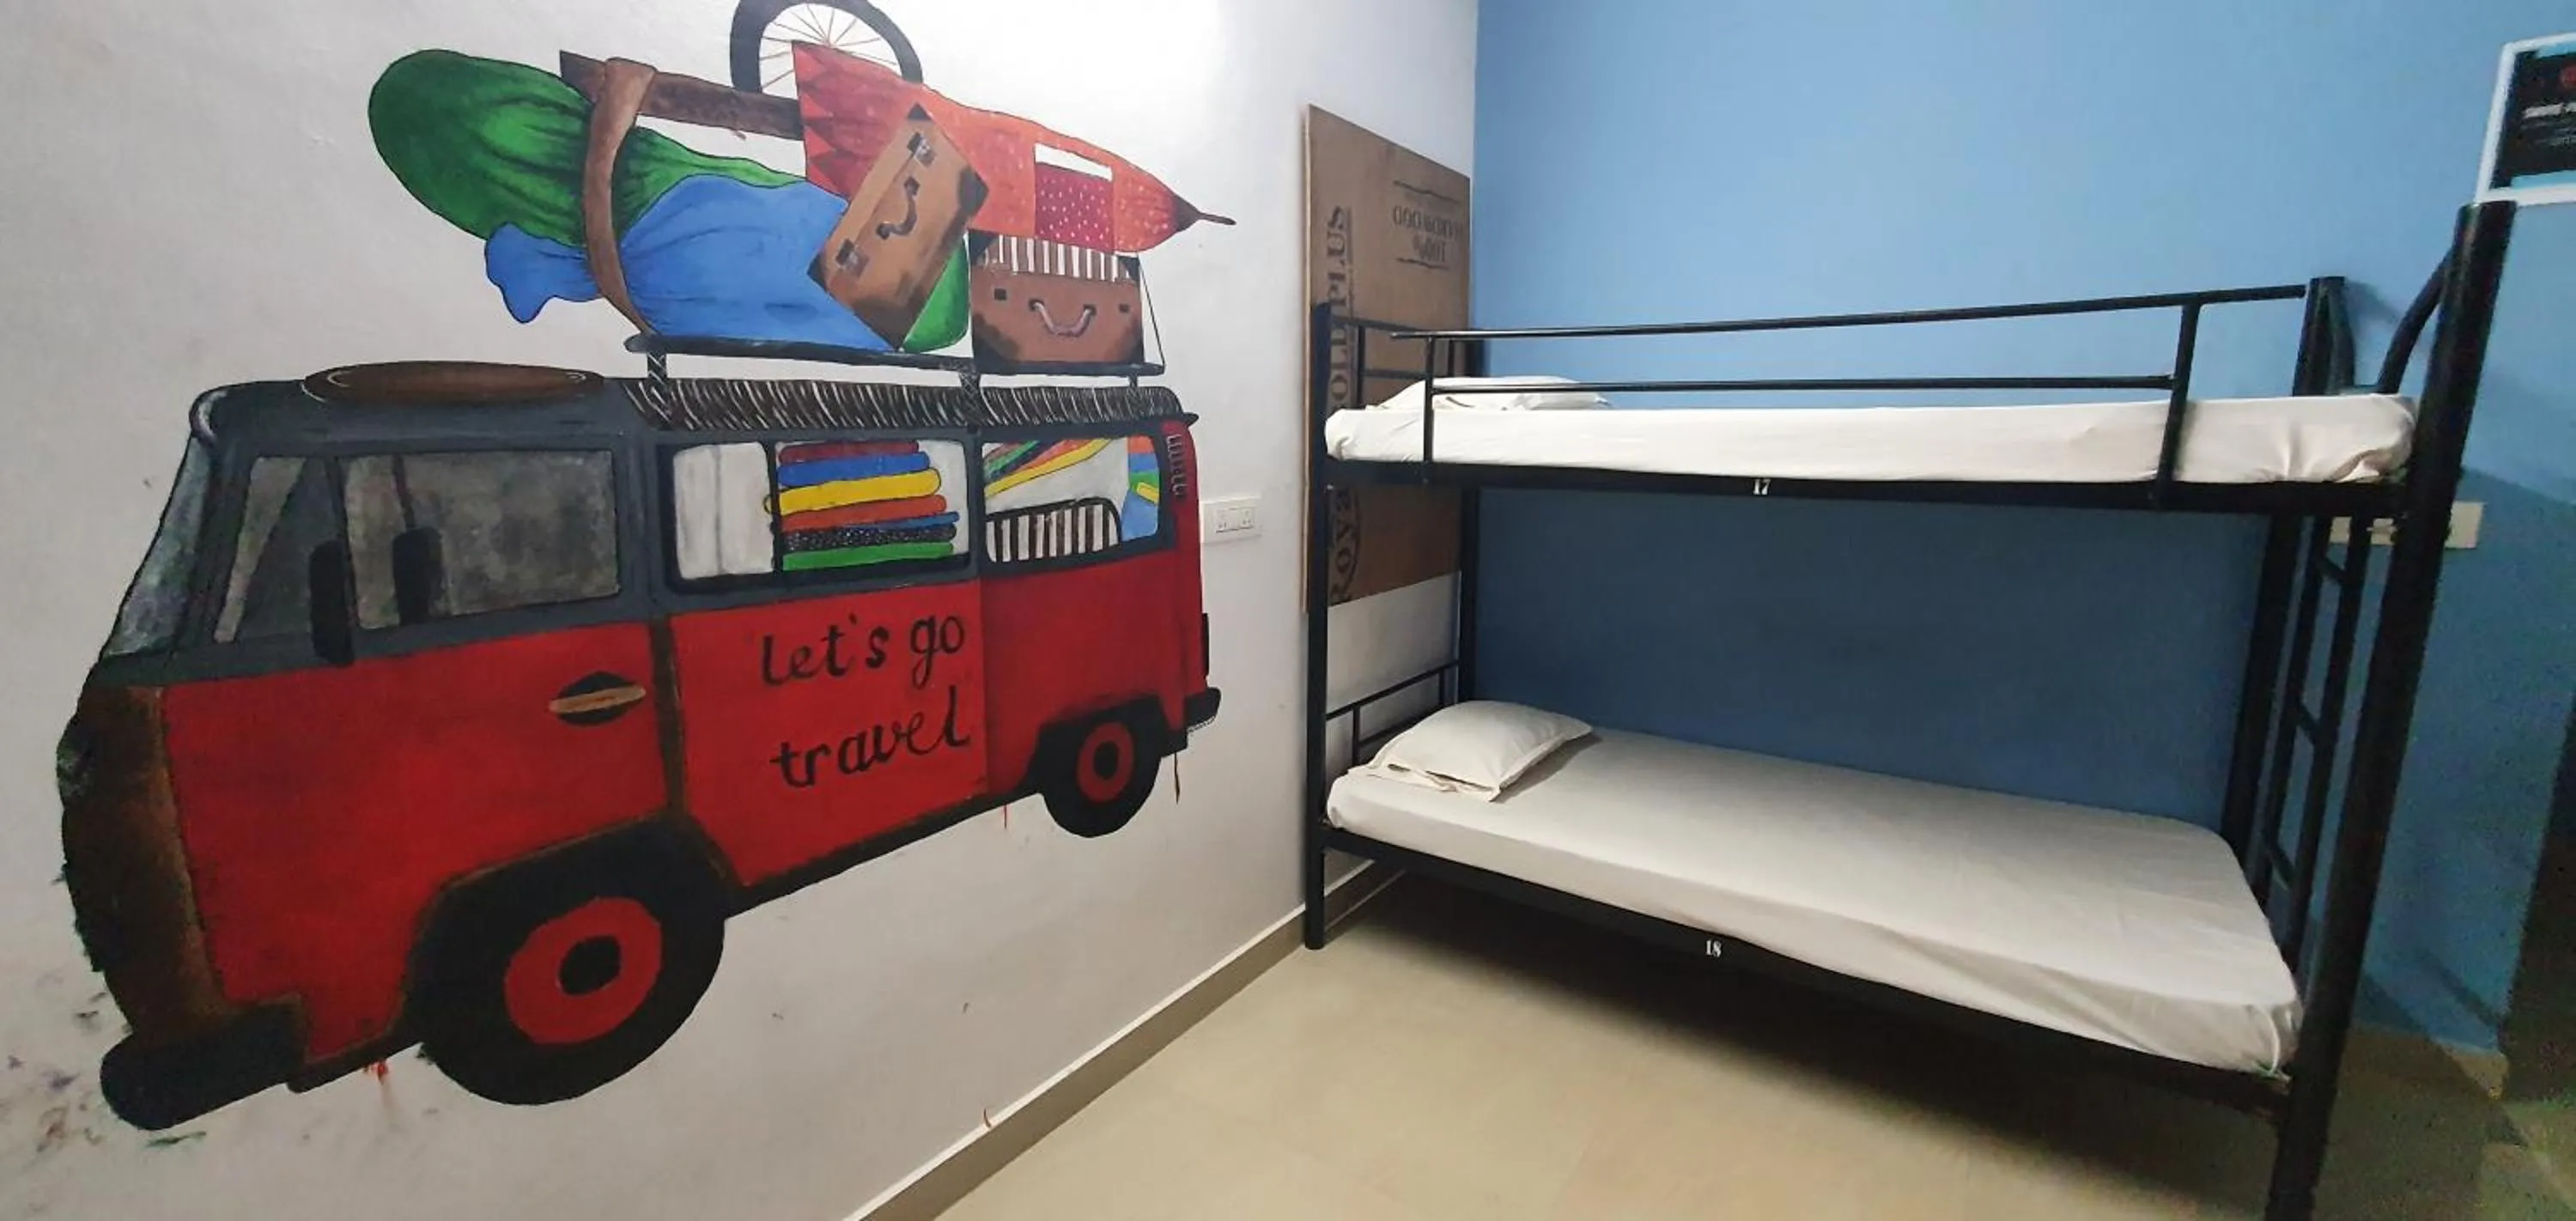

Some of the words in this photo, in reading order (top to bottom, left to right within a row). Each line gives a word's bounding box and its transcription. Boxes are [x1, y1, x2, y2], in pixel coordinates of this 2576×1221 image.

[1327, 206, 1347, 307] PLUS
[1330, 324, 1348, 410] OLD
[1753, 478, 1771, 495] 17
[762, 612, 889, 685] let's
[909, 616, 964, 689] go
[769, 685, 970, 788] travel
[1705, 940, 1722, 957] 18
